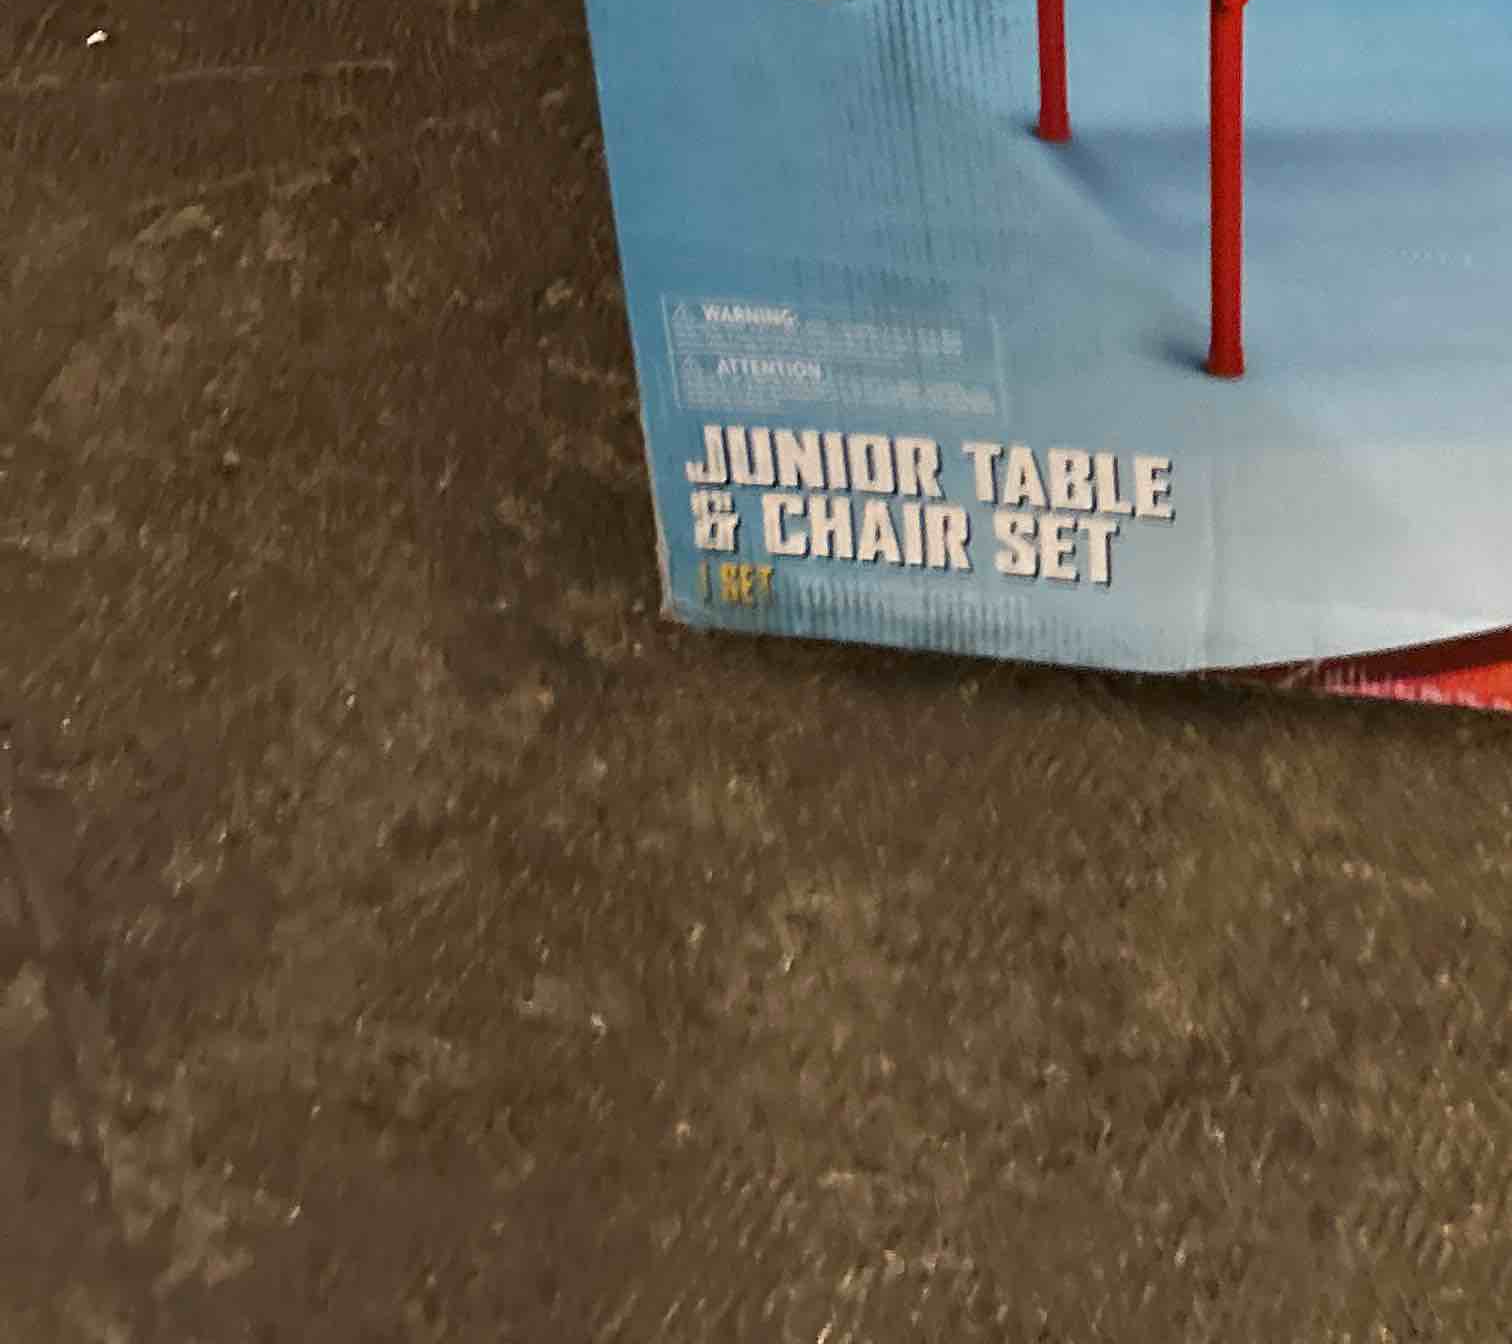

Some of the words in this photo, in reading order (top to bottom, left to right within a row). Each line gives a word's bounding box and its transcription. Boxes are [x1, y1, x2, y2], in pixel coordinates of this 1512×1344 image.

[686, 424, 941, 499] JUNIOR
[962, 441, 1175, 520] TABLE
[691, 491, 739, 552] &
[761, 493, 971, 572] CHAIR
[993, 510, 1120, 587] SET
